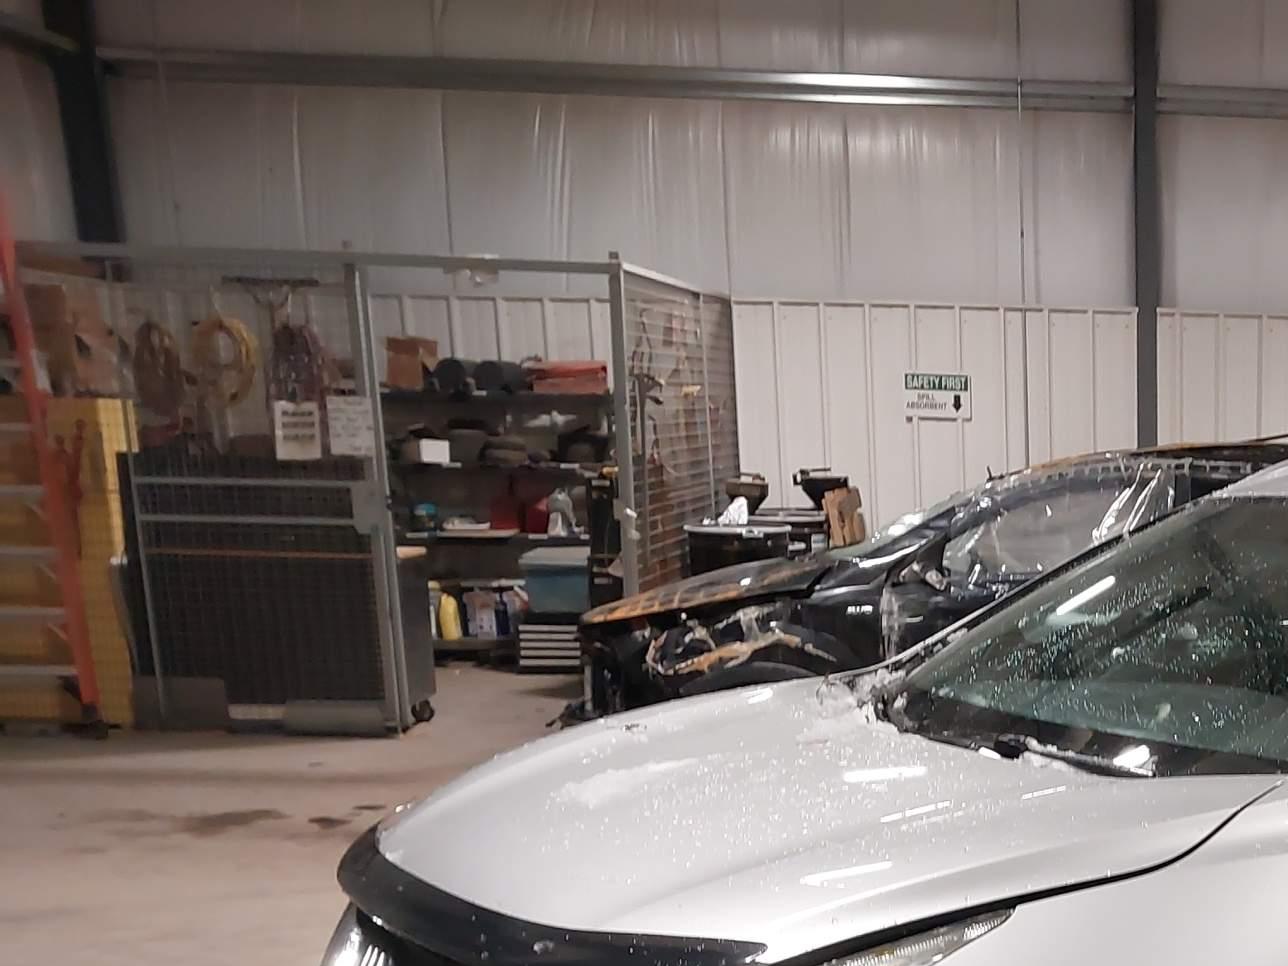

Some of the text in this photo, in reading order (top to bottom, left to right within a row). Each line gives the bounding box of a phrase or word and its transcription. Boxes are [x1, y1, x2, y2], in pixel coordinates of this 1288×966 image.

[906, 375, 966, 391] SAFETY FIRST
[906, 401, 947, 410] ABSORBENT
